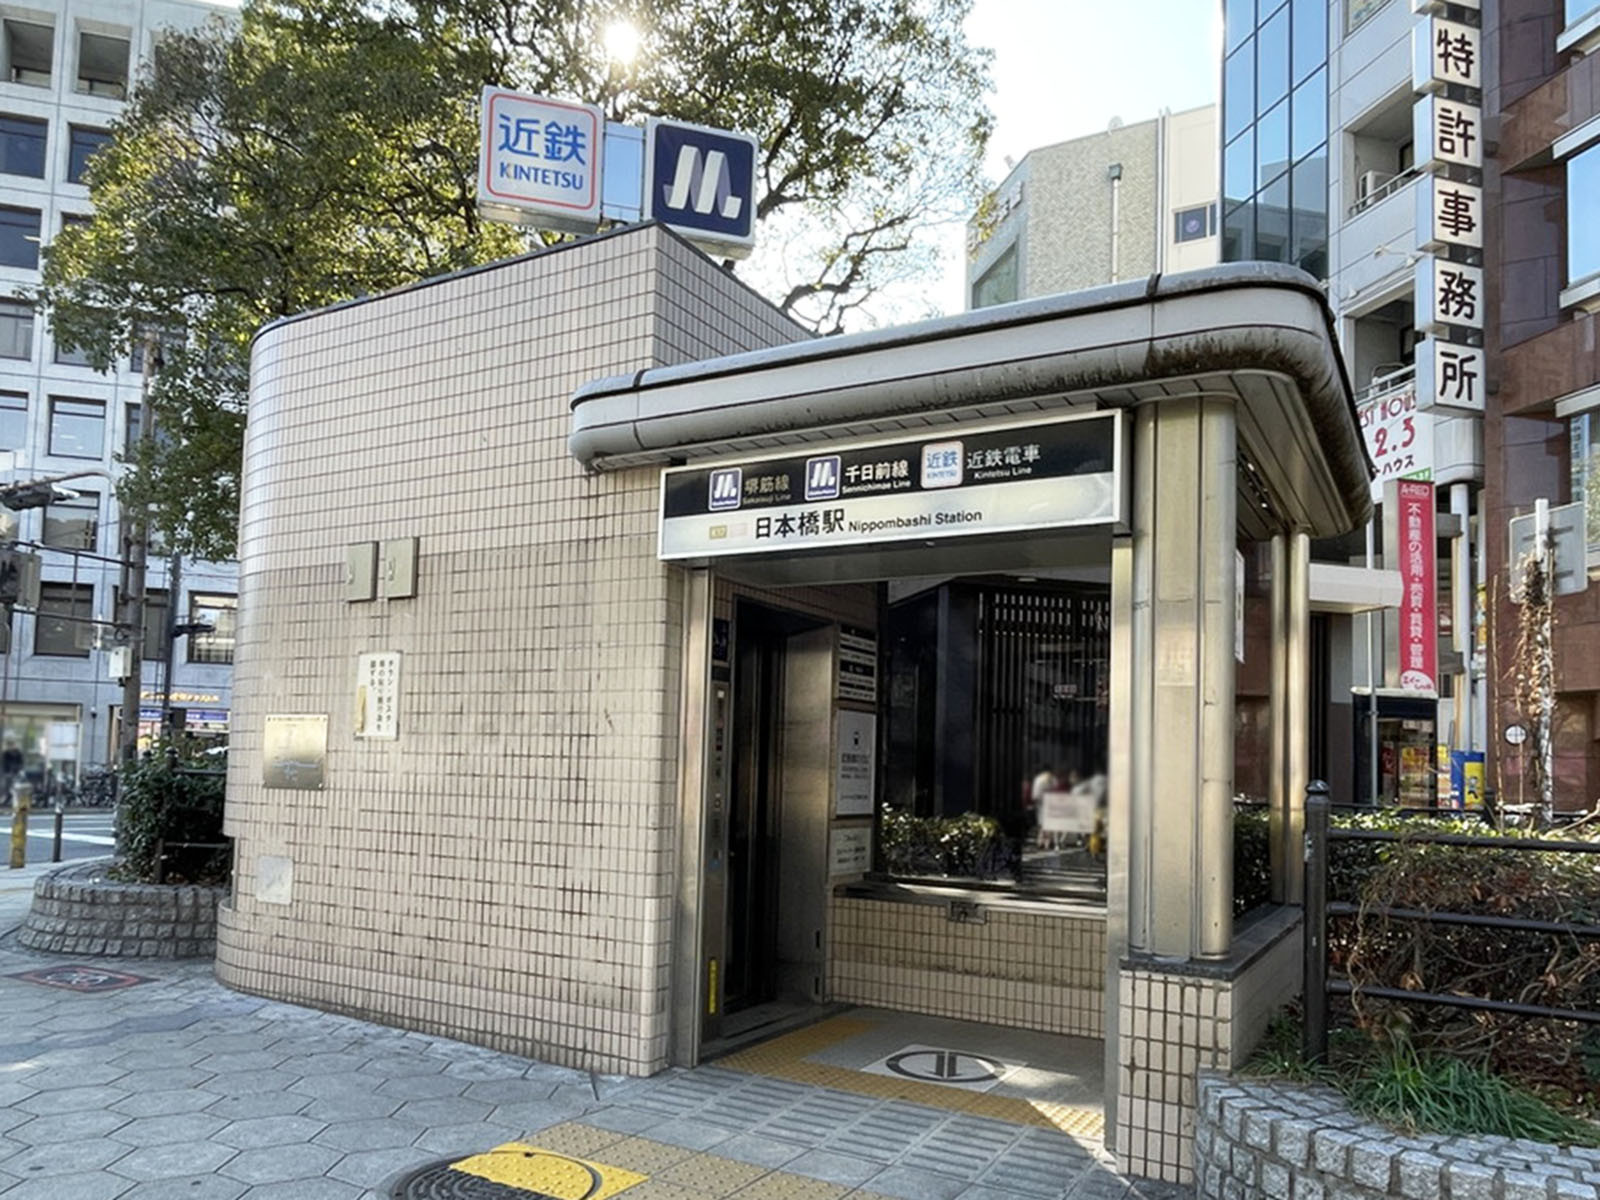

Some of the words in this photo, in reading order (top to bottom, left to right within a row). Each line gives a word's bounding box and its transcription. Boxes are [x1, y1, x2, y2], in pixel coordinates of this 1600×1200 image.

[498, 113, 586, 166] 近鉄
[500, 161, 584, 190] KINTETSU
[1436, 28, 1477, 401] 特許事務所
[926, 450, 958, 469] 近鉄
[966, 443, 1041, 470] 近鉄電車
[845, 459, 909, 483] 千日前線
[893, 479, 912, 489] Line
[973, 469, 1011, 480] Kintetsu
[1011, 466, 1033, 477] Line
[755, 508, 845, 539] 日本橋駅
[849, 513, 932, 534] Nippombashi
[934, 509, 983, 526] Station
